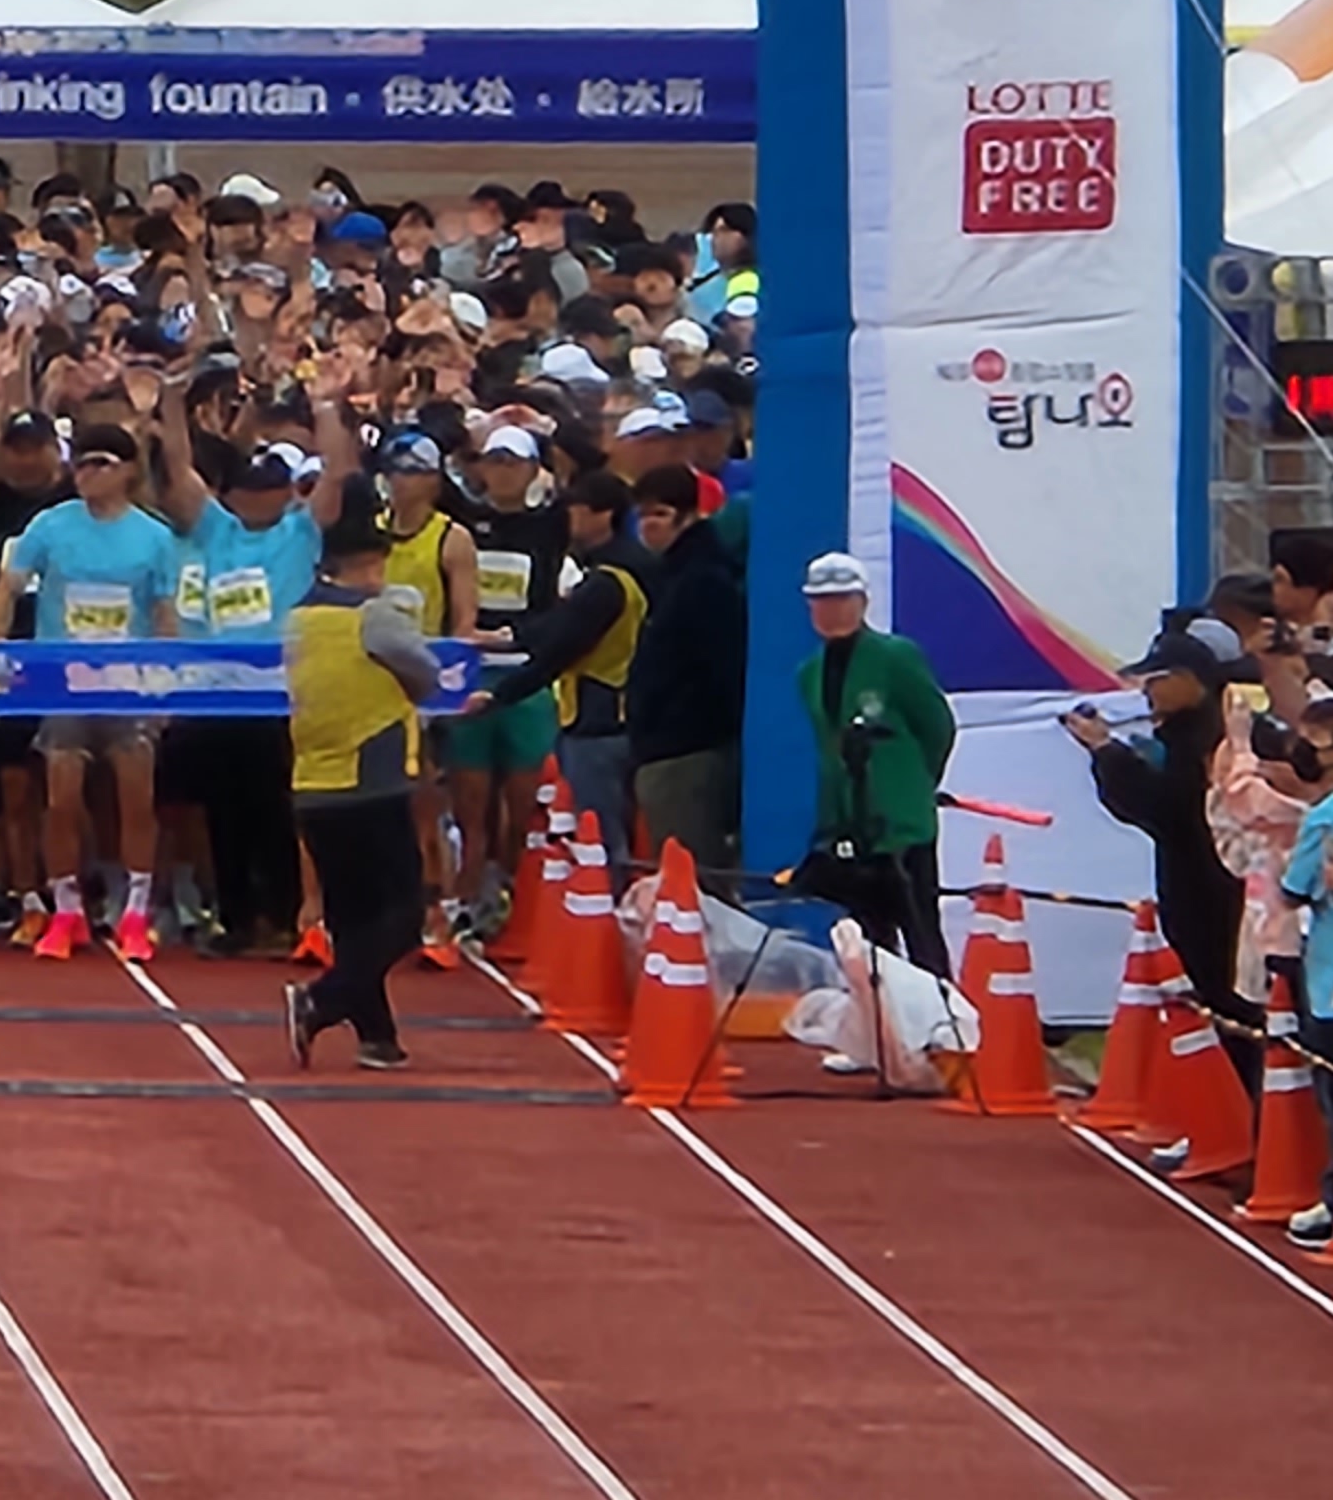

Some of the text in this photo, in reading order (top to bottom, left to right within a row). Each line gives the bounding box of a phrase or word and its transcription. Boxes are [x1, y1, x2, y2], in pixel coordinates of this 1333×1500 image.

[148, 71, 328, 115] fountain
[966, 80, 1113, 114] LOTTE
[979, 137, 1105, 175] DUTY
[977, 177, 1102, 215] FREE
[987, 372, 1132, 450] 탐나오
